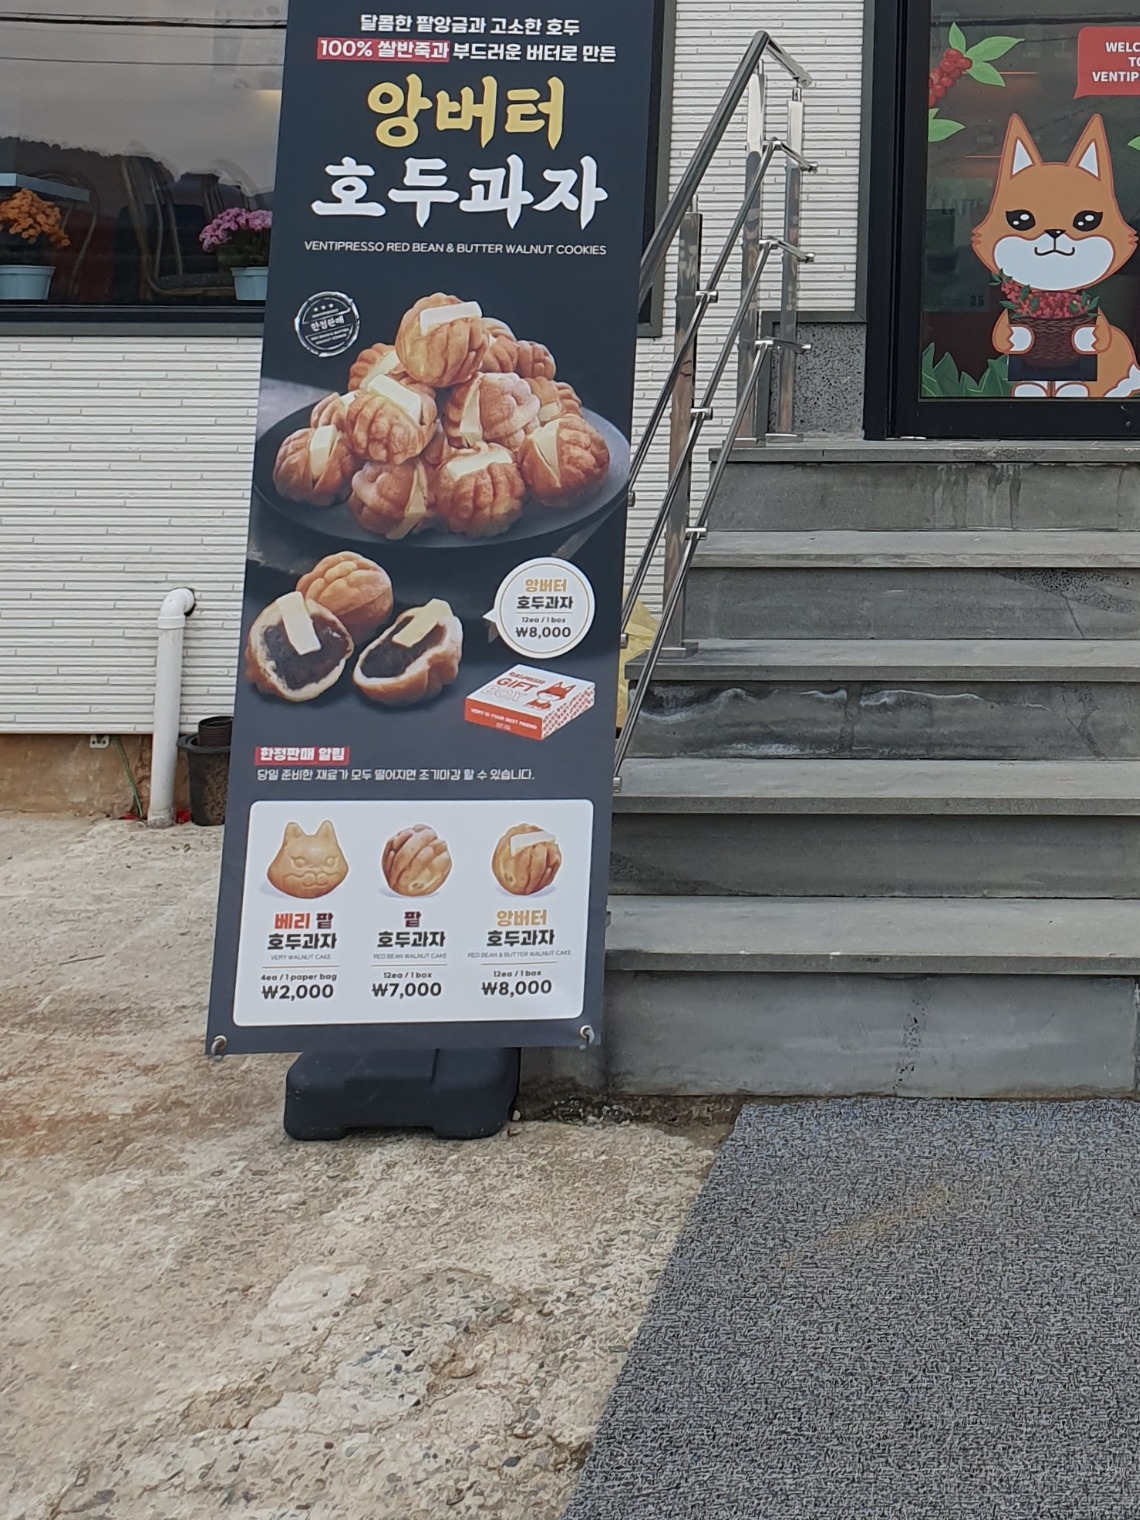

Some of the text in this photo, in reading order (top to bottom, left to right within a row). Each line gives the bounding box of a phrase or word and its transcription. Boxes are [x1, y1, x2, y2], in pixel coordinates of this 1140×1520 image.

[360, 14, 580, 36] 달콤한 팥앙금과 고소한 호두
[320, 40, 616, 63] 100% 쌀반죽과 부드러운 버터로 만든
[367, 73, 565, 150] 앙버터
[311, 154, 609, 230] 호두과자
[304, 240, 607, 256] VENTIPRESSO RED BEAN & BUTTER WALNUT COOKIES
[525, 578, 567, 593] 앙버터
[517, 595, 573, 610] 호두과자
[515, 626, 572, 640] ₩8,000
[496, 677, 539, 693] GIFT
[260, 746, 345, 761] 한정판매 알림
[257, 768, 279, 781] 당일
[281, 768, 313, 781] 준비한
[315, 768, 349, 781] 재료가
[351, 768, 372, 781] 모두
[419, 768, 461, 781] 조기마감
[463, 768, 475, 780] 할
[477, 768, 487, 781] 수
[490, 768, 535, 781] 있습니다.
[274, 912, 334, 929] 베리 팥
[404, 911, 422, 928] 팥
[496, 909, 547, 927] 앙버터
[267, 933, 338, 950] 호두과자
[377, 931, 446, 948] 호두과자
[486, 929, 555, 947] 호두과자
[290, 974, 317, 982] paper
[319, 973, 338, 982] bag
[383, 971, 403, 979] 12ea
[415, 971, 432, 979] box
[493, 970, 512, 978] 12ea
[525, 969, 542, 977] box
[261, 983, 335, 1001] ₩2,000
[371, 981, 443, 1000] ₩7,000
[481, 979, 552, 998] ₩8,000
